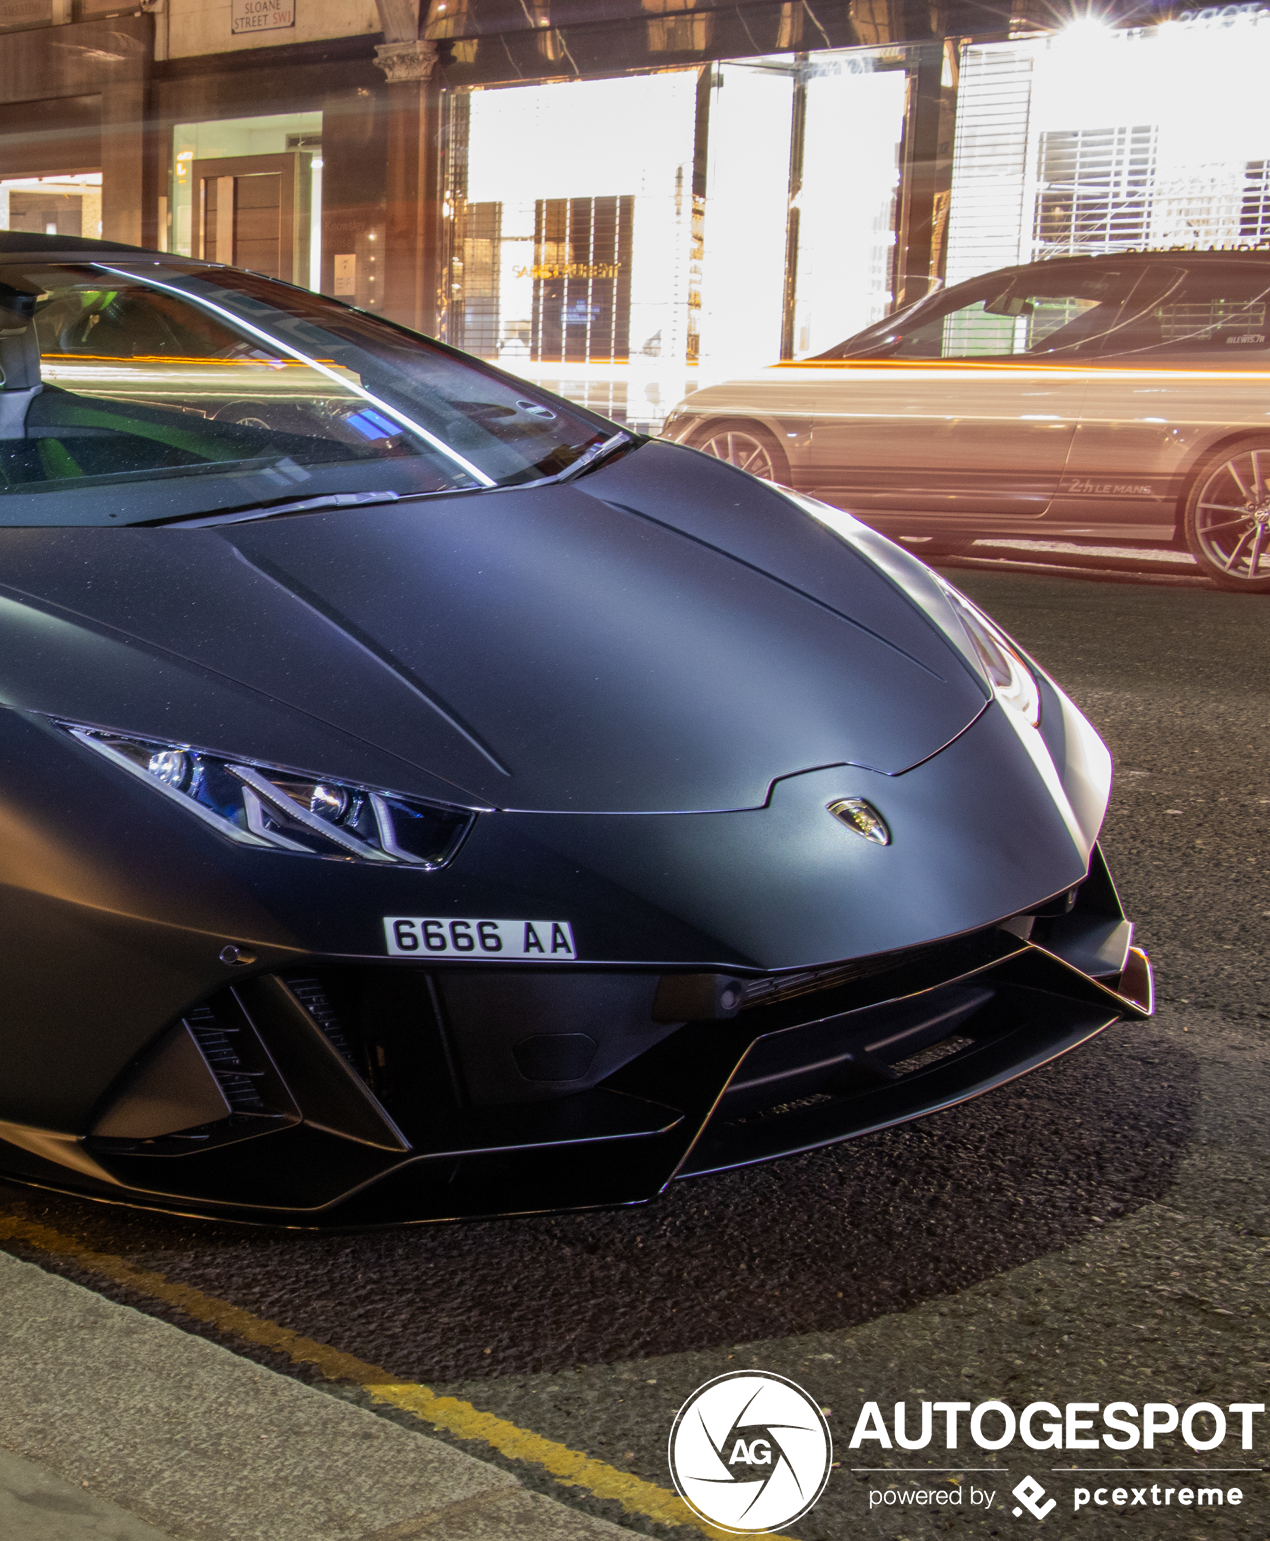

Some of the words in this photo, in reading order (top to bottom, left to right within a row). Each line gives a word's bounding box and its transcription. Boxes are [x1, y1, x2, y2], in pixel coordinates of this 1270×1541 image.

[245, 0, 281, 14] SLOANE
[1095, 484, 1112, 493] LE
[1113, 485, 1151, 494] MANS
[393, 920, 503, 952] 6666
[523, 922, 573, 953] AA
